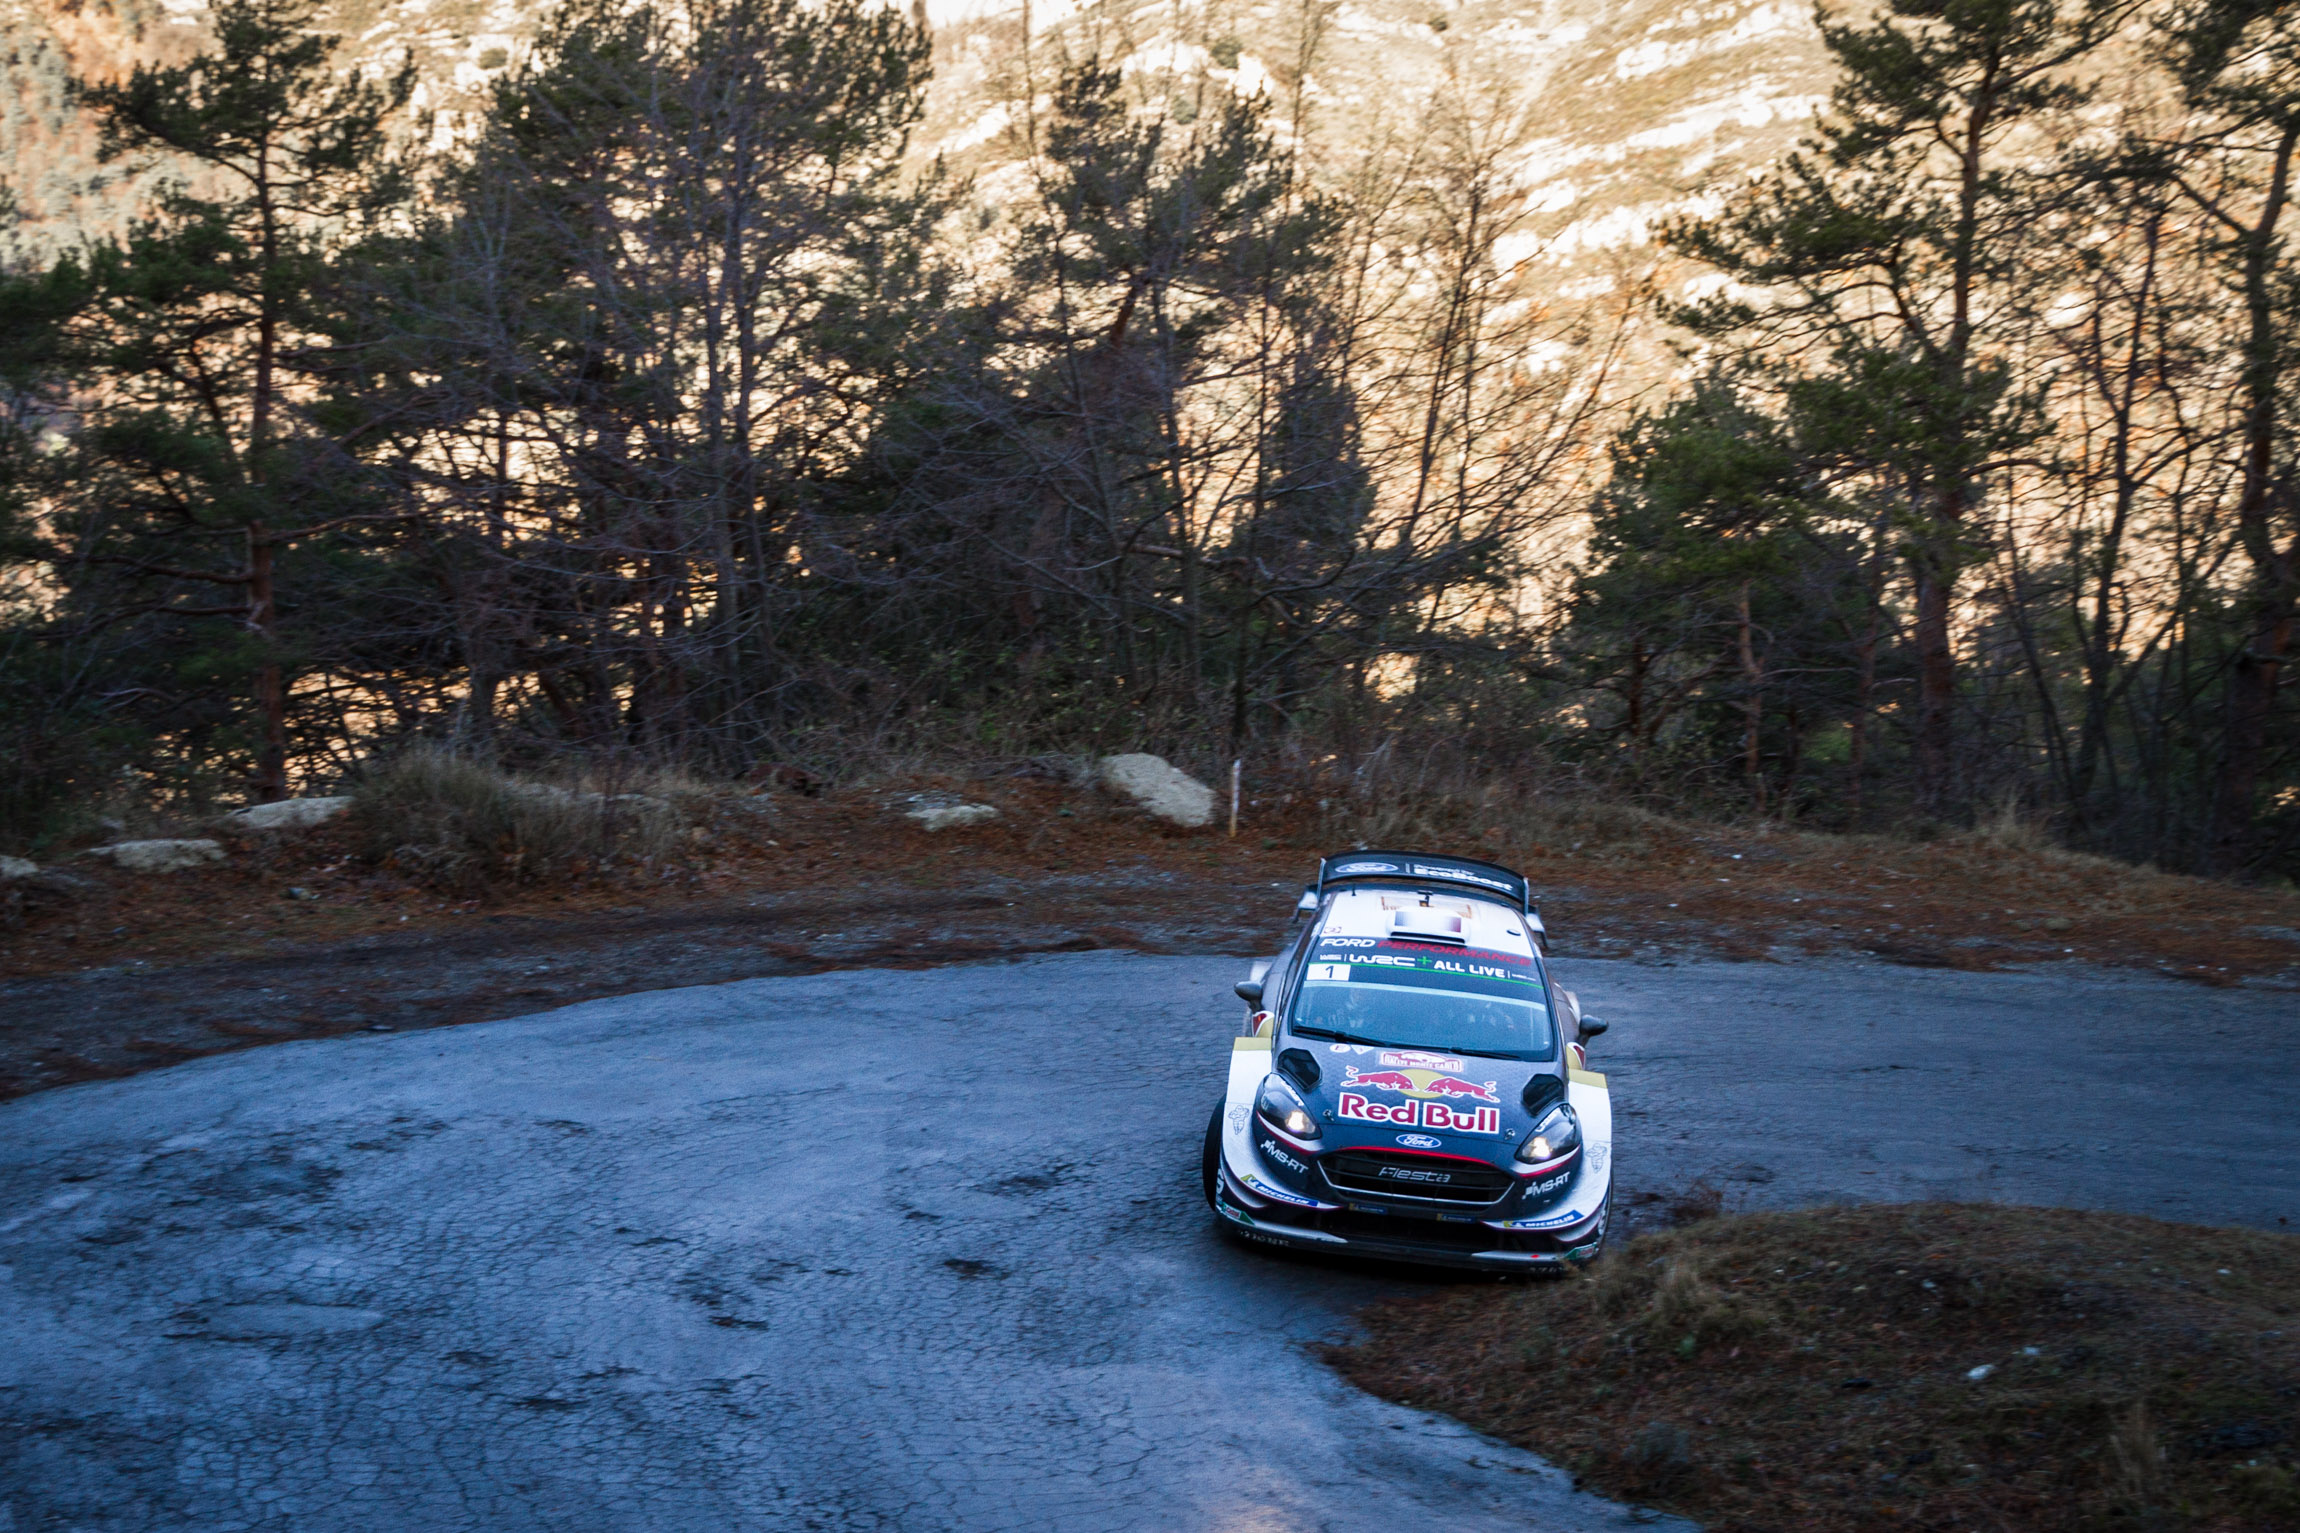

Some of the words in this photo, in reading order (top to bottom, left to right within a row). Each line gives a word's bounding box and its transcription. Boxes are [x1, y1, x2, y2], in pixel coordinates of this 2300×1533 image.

[1414, 868, 1513, 891] EcoBoost
[1320, 938, 1376, 948] FORD
[1377, 940, 1531, 967] PERFORMANCE
[1325, 965, 1334, 979] 1
[1433, 960, 1465, 972] ALL
[1469, 964, 1505, 978] LIVE
[1340, 1093, 1418, 1125] Red
[1424, 1102, 1498, 1133] Bull
[1403, 1135, 1434, 1147] Ford
[1268, 1146, 1309, 1174] MS-RT
[1378, 1166, 1451, 1183] Fiesta
[1533, 1171, 1571, 1196] MS-RT
[1257, 1185, 1310, 1204] MICHELIN
[1525, 1214, 1575, 1228] MICHELIN
